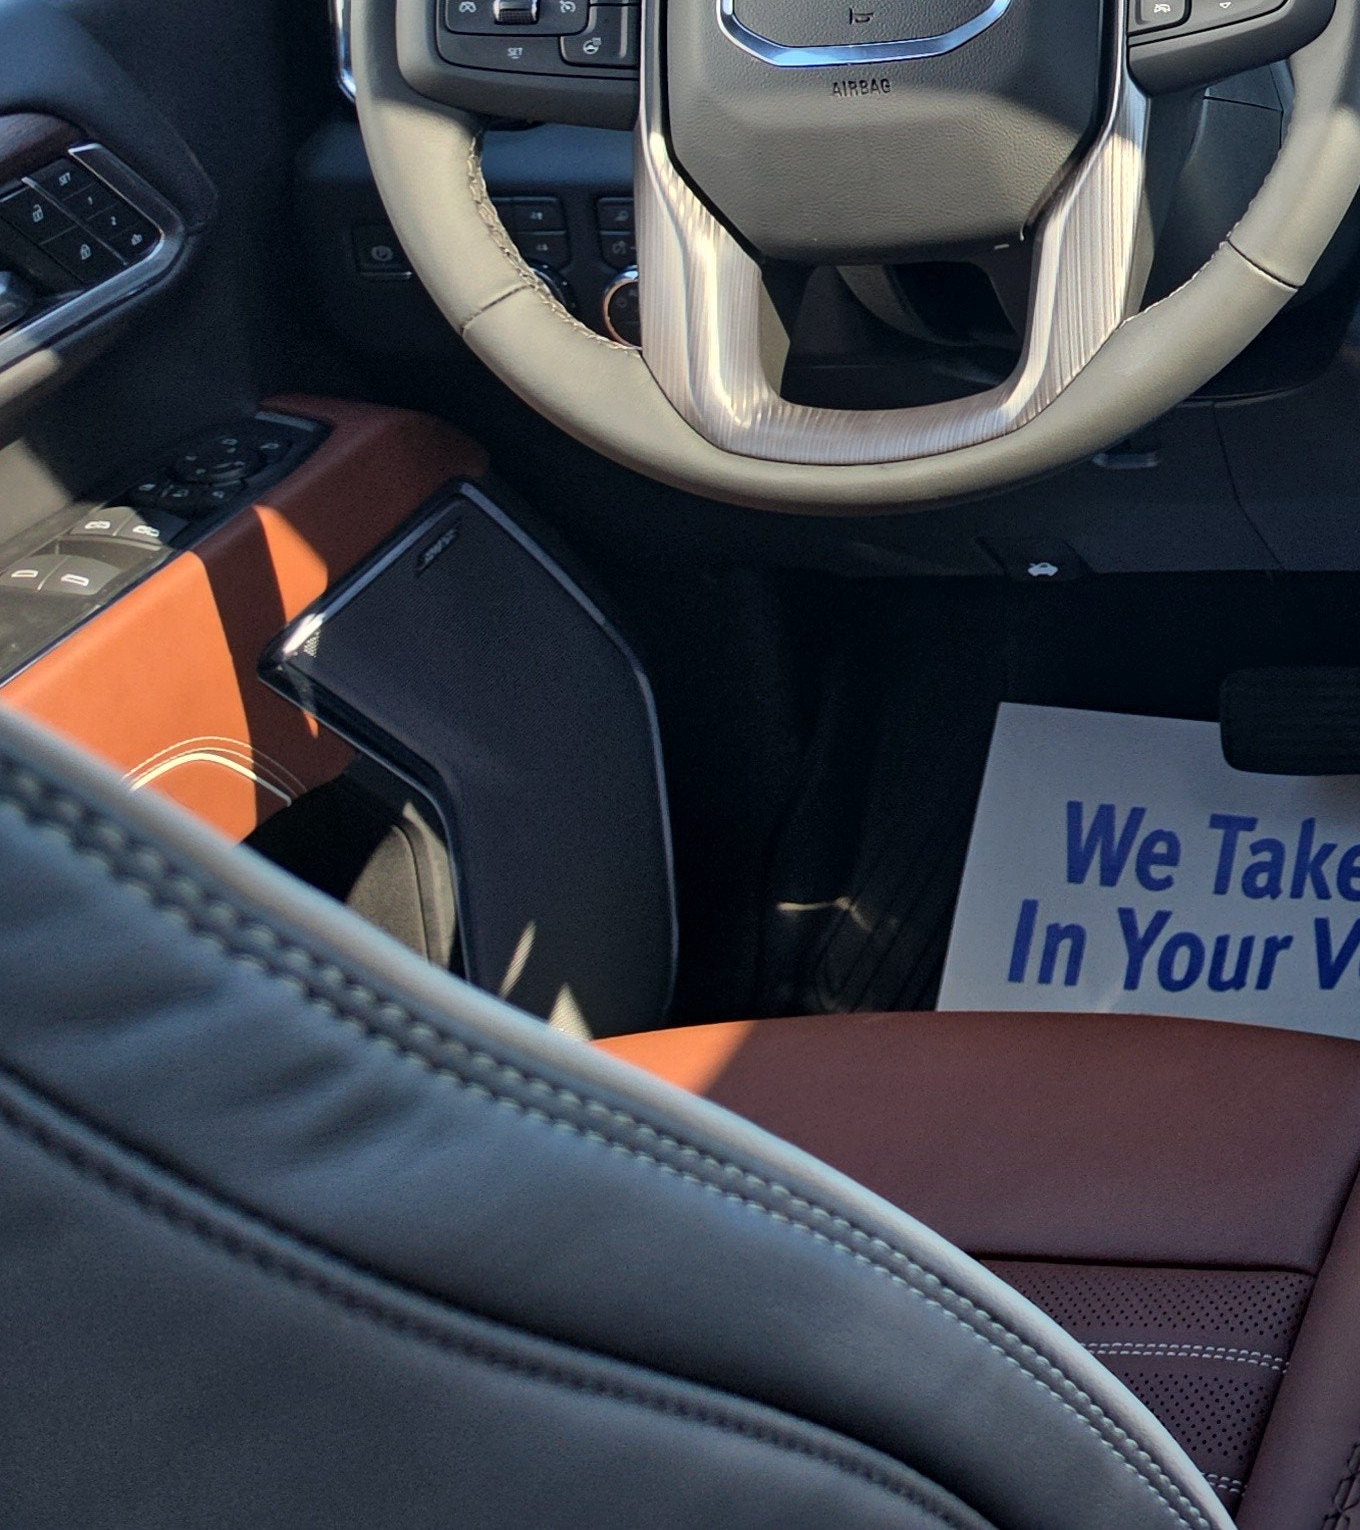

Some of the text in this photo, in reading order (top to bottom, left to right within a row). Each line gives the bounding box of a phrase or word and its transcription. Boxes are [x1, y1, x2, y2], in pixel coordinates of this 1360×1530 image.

[507, 46, 523, 57] SET
[832, 78, 891, 97] AIRBAG
[1064, 800, 1182, 892] We
[1007, 898, 1087, 986] In
[1117, 907, 1293, 993] Your
